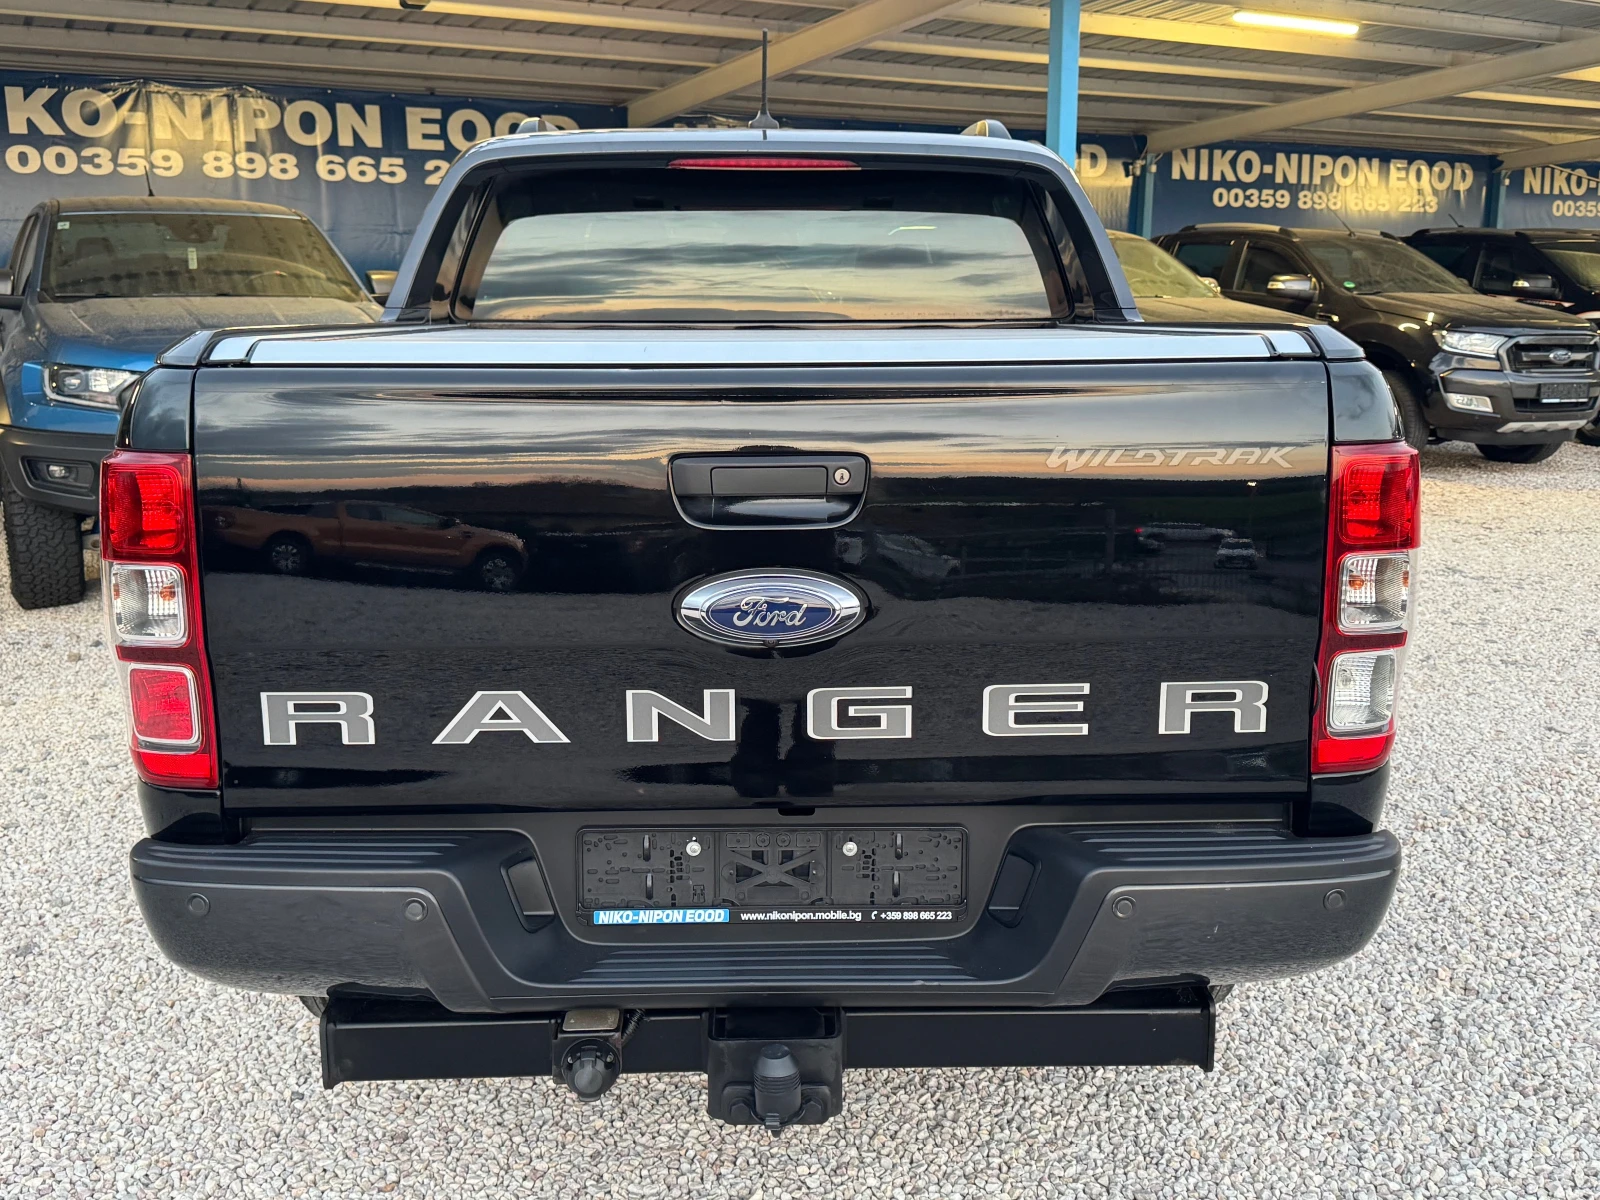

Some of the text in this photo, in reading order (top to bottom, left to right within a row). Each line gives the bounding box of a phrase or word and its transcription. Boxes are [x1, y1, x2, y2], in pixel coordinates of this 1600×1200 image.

[4, 86, 383, 148] KO-NIPON
[5, 145, 184, 177] 00359
[202, 151, 300, 181] 898
[316, 154, 408, 184] 665
[1171, 148, 1474, 191] NIKO-NIPON EOOD
[1523, 167, 1600, 196] NIKO-
[1212, 187, 1439, 213] 00359 898 665 223
[1552, 199, 1600, 217] 0035
[1046, 445, 1297, 471] WILDTRAK
[733, 596, 808, 627] Ford
[259, 679, 1270, 748] RANGER
[598, 909, 725, 924] NIKO-NIPON EOOD
[740, 910, 952, 922] www.nikonipon.mobile.bg +359 898 665 223
